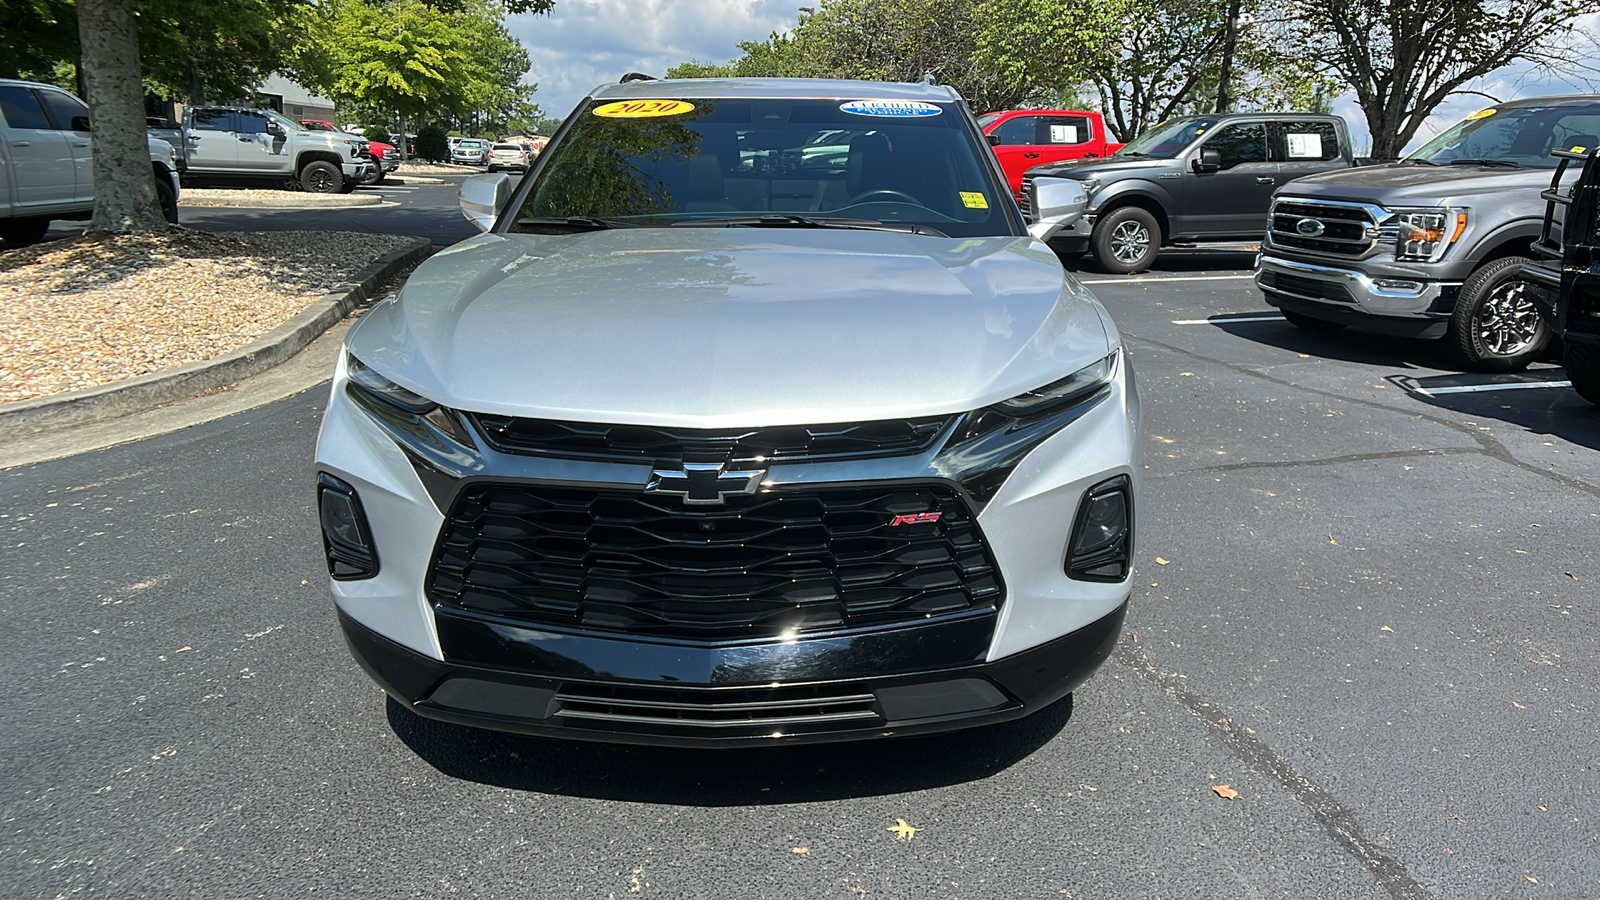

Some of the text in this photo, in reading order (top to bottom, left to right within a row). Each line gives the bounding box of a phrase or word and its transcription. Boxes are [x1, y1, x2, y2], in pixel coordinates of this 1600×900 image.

[607, 102, 680, 114] 2020
[851, 101, 930, 109] CERTIFIED
[1472, 318, 1482, 354] MICHELIN
[888, 511, 943, 526] RS
